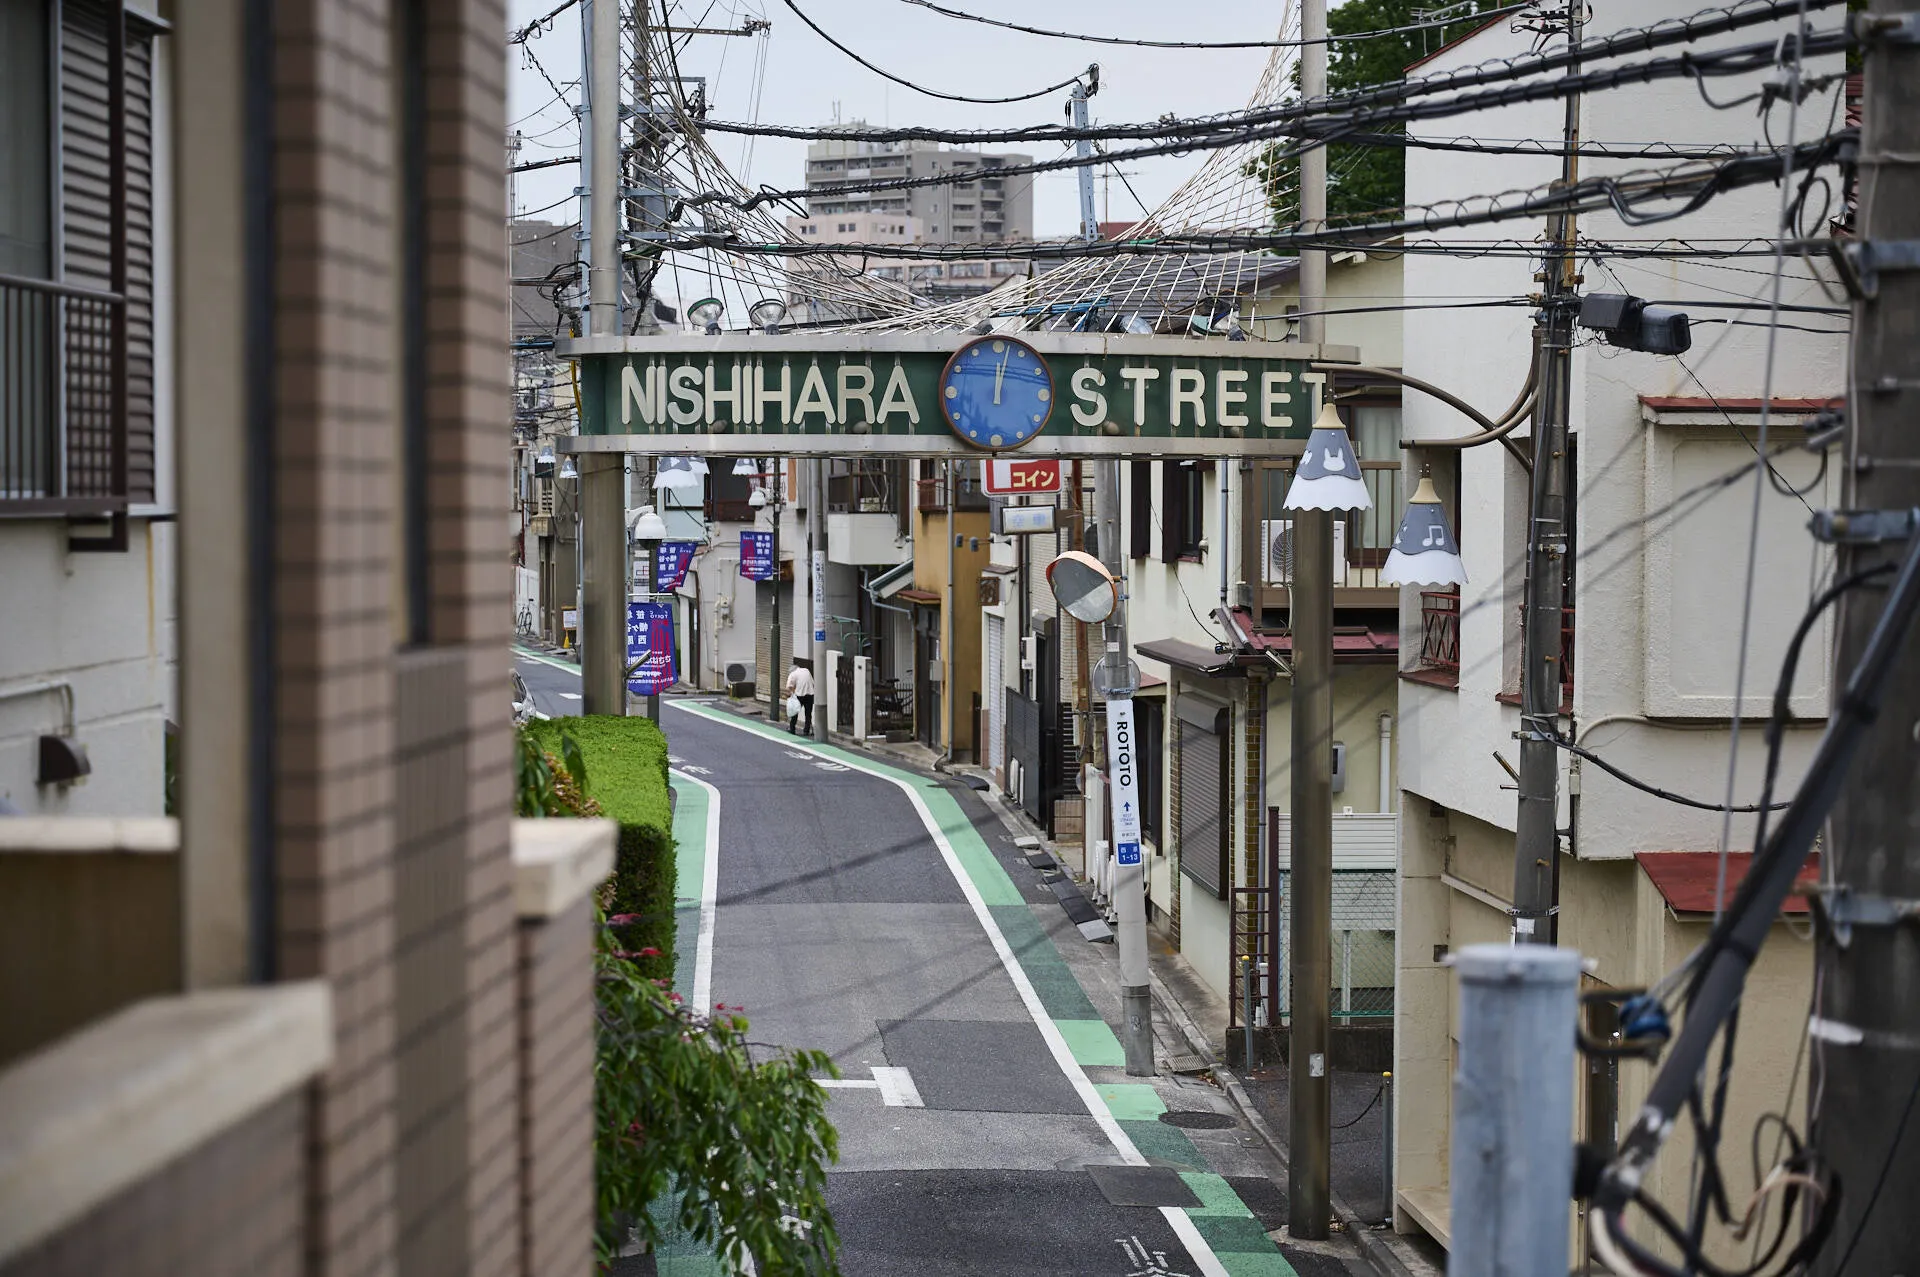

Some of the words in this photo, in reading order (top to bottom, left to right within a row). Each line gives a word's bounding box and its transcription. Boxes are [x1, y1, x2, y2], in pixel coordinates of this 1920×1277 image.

[622, 366, 920, 425] NISHIHARA
[1070, 367, 1327, 428] STREET
[1012, 470, 1055, 488] コイン
[1116, 721, 1132, 787] ROTOTO
[1122, 853, 1138, 861] 1-13
